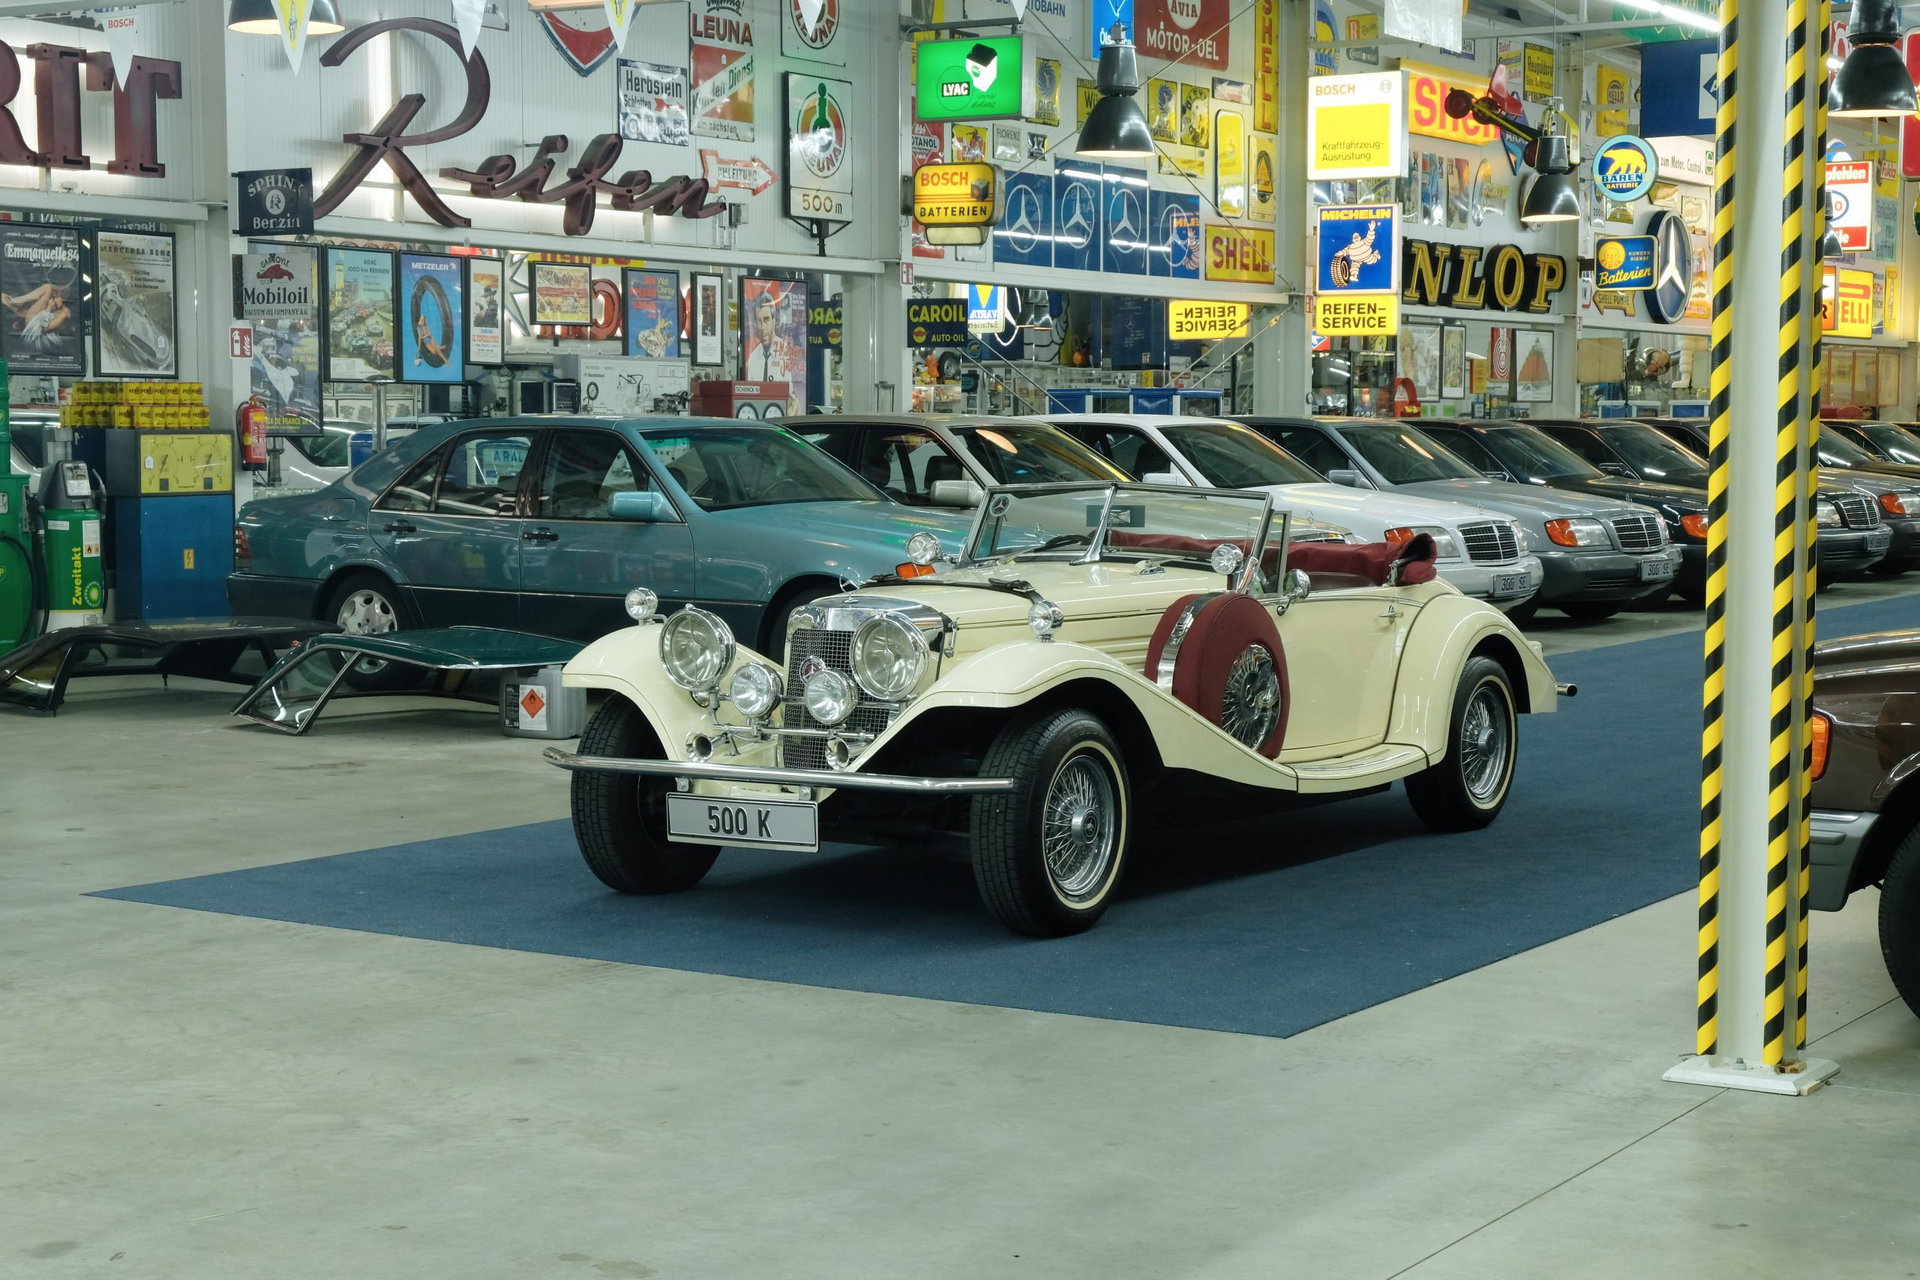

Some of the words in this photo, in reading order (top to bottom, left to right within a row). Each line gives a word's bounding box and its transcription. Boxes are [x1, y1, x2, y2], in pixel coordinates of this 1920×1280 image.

[1170, 1, 1198, 18] AVIA
[108, 18, 134, 28] BOSCH
[692, 13, 754, 47] LEUNA
[728, 55, 754, 89] Dienst
[626, 70, 682, 98] Herbstein
[943, 83, 969, 96] LYAC
[1315, 84, 1356, 96] BOSCH
[314, 17, 728, 236] Reifen
[911, 138, 938, 149] OTANOL
[1660, 156, 1670, 167] zum
[717, 165, 758, 182] UMLEITUNG
[920, 172, 969, 187] BOSCH
[1825, 165, 1866, 185] pfehlen
[1606, 181, 1639, 190] BATTERIE
[802, 194, 833, 213] 500
[835, 202, 843, 215] m
[919, 205, 987, 217] BATTERIEN
[1321, 208, 1391, 220] MICHELIN
[1211, 235, 1270, 273] SHELL
[411, 262, 449, 271] METZELER
[1403, 238, 1567, 314] NLOP
[1597, 266, 1652, 287] Batterien
[243, 287, 308, 305] Mobiloil
[909, 304, 966, 323] CAROIL
[1322, 316, 1387, 329] SERVICE
[72, 547, 82, 606] Zweitakt
[1648, 563, 1659, 576] 300
[1663, 562, 1670, 575] SE
[1502, 577, 1514, 591] 300
[1518, 576, 1527, 590] SE
[708, 805, 748, 835] 500
[757, 809, 773, 838] K
